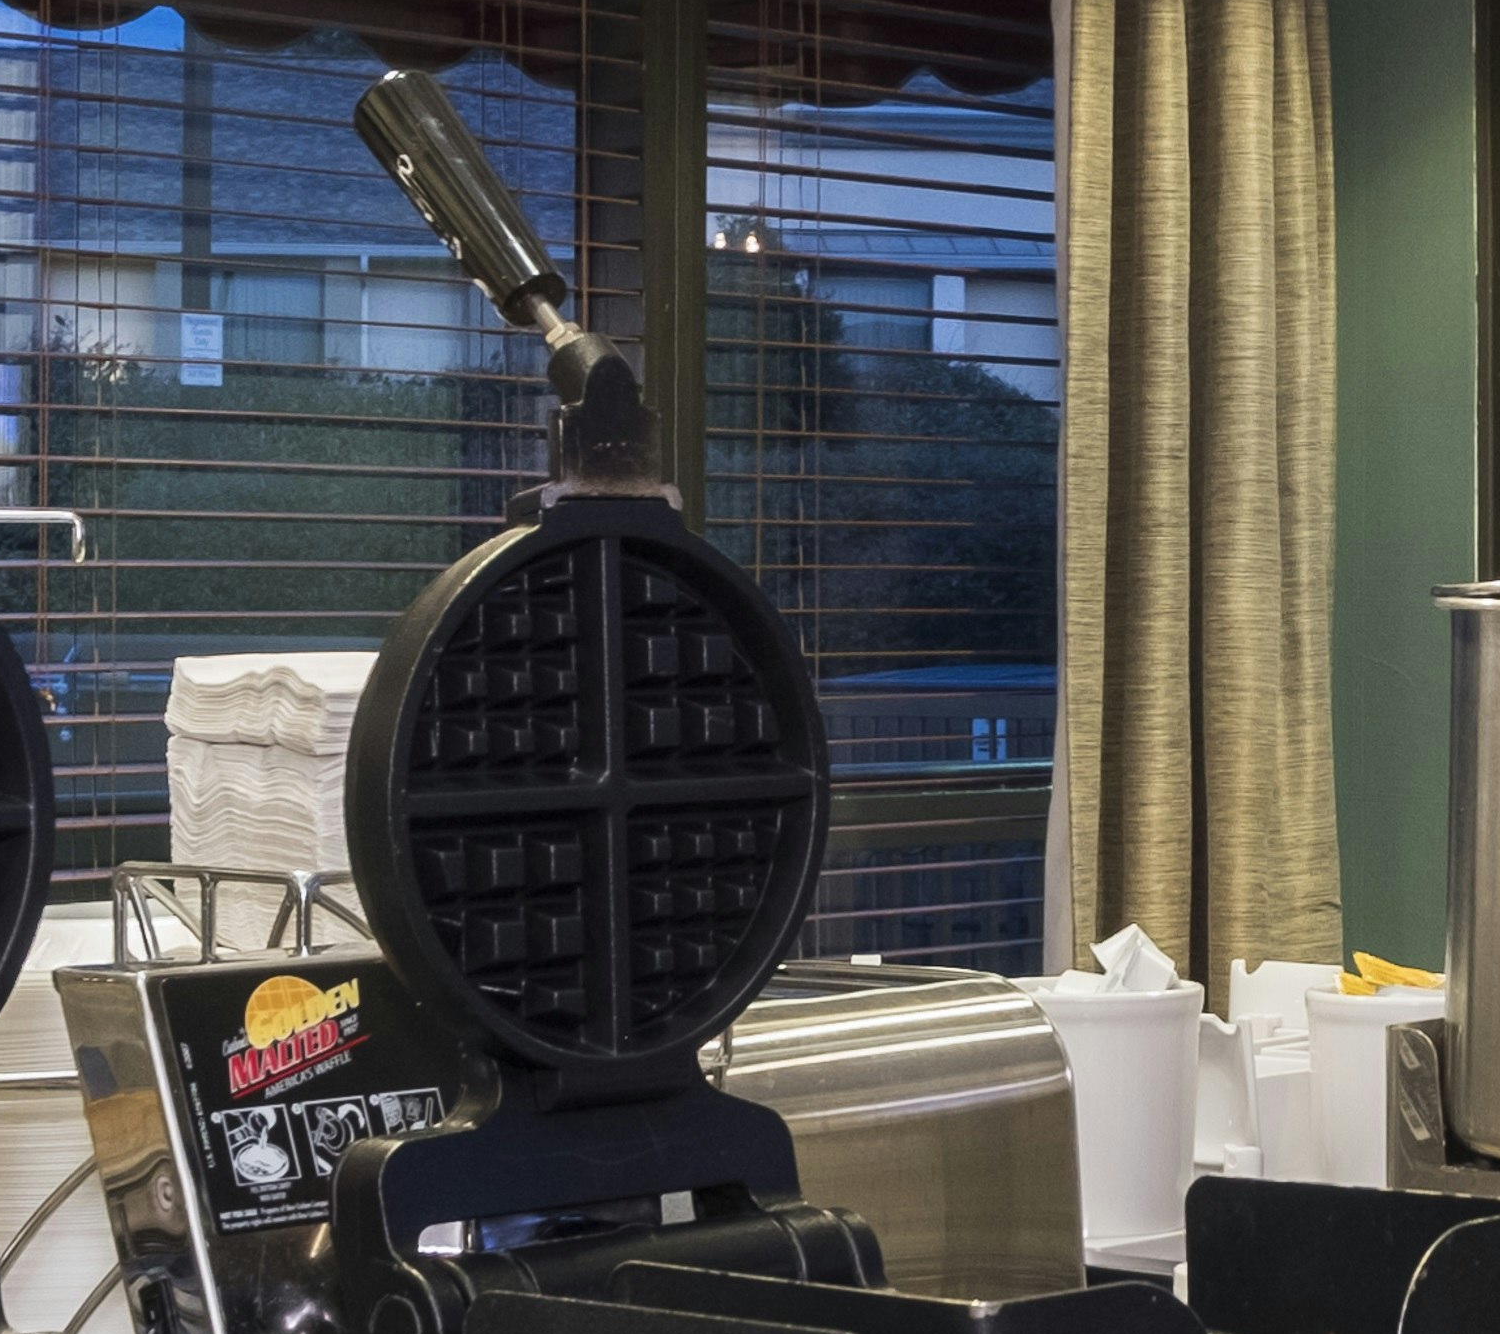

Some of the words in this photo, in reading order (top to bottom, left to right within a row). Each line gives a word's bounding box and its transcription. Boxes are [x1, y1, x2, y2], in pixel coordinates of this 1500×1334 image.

[248, 978, 361, 1050] GOLDEN
[227, 1019, 339, 1094] MALTED
[264, 1072, 314, 1099] AMERICA'S
[315, 1050, 352, 1076] WAFFLE
